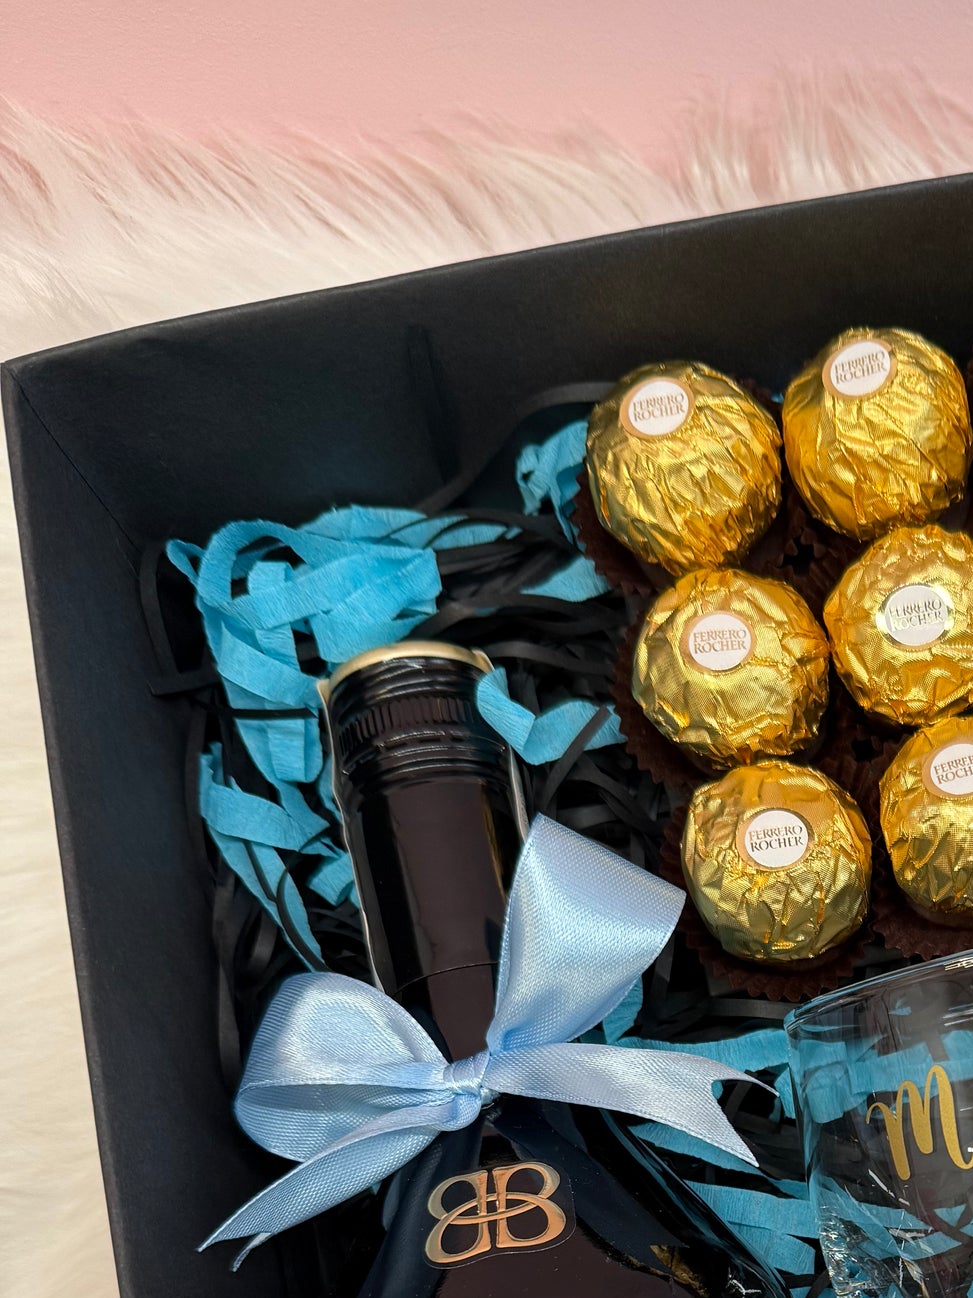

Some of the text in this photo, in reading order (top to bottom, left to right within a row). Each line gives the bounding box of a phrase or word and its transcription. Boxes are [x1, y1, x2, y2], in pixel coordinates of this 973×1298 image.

[834, 351, 885, 374] FERRERO
[836, 362, 887, 385] ROCHER
[632, 393, 684, 411] FERRERO
[633, 404, 686, 423] ROCHER
[887, 599, 942, 620] FERRERO
[890, 611, 944, 632] ROCHER
[692, 628, 747, 643] FERRERO
[693, 639, 747, 655] ROCHER
[748, 824, 803, 841] FERRERO
[750, 835, 804, 853] ROCHER
